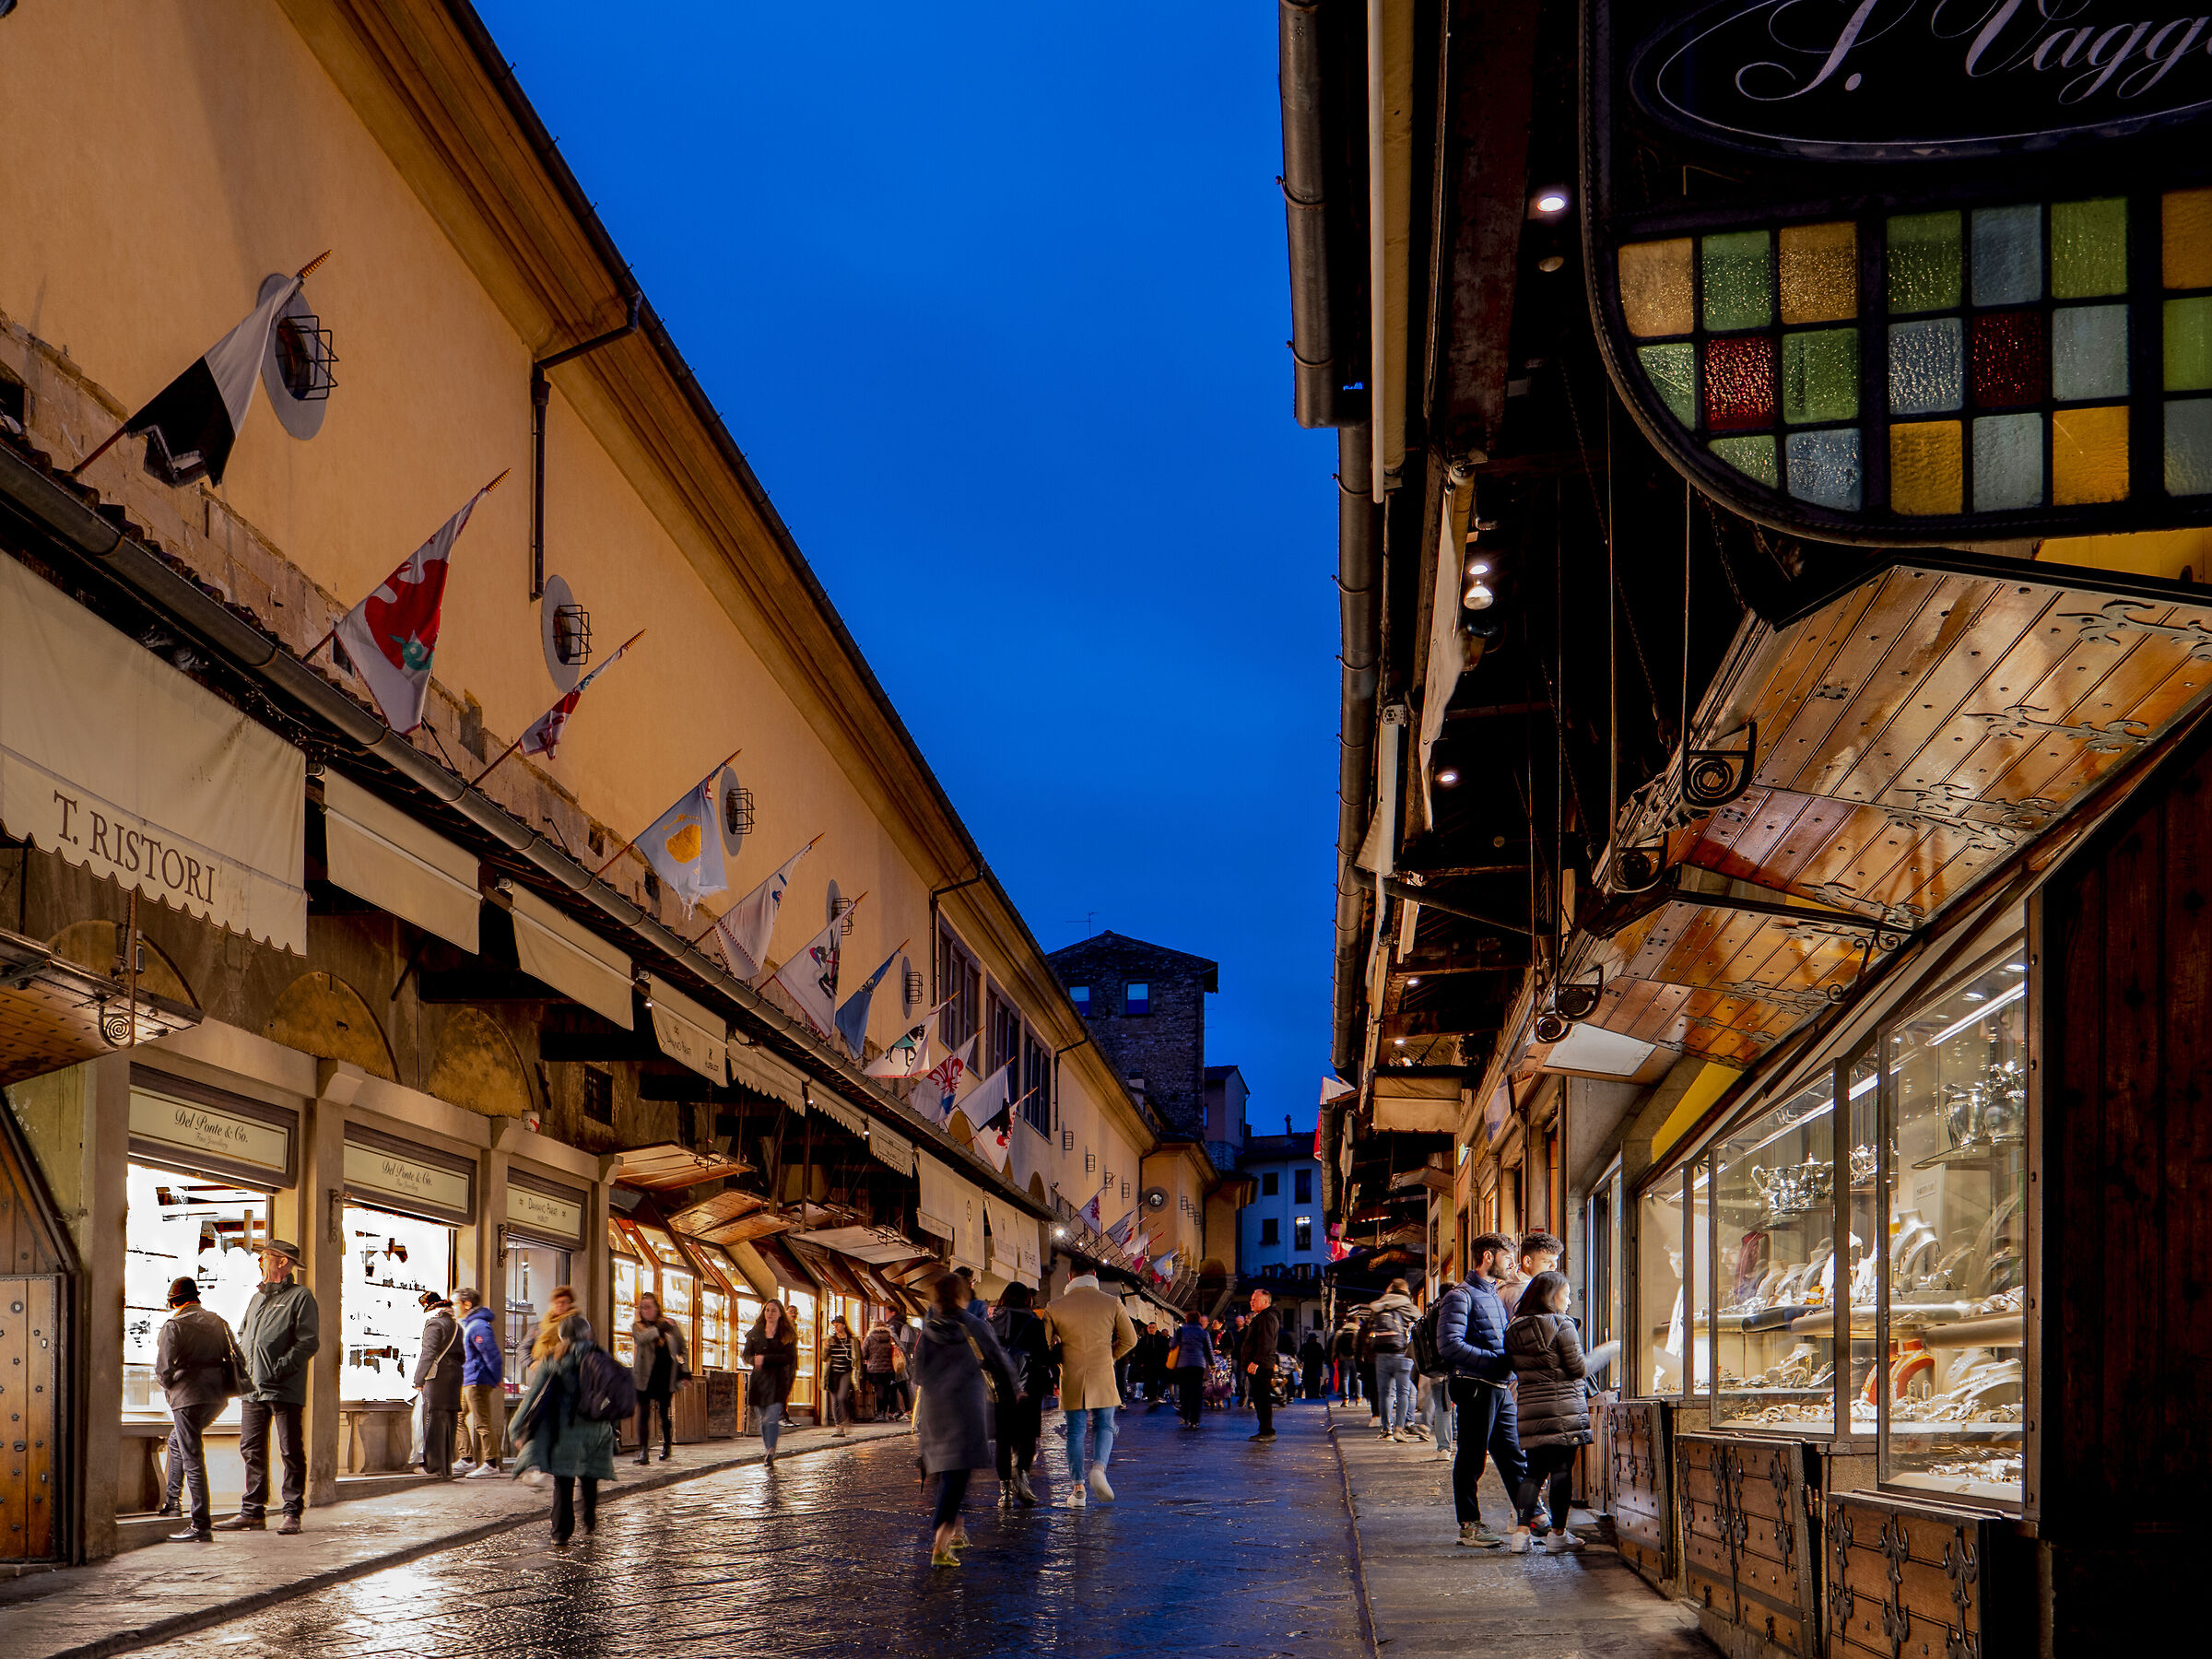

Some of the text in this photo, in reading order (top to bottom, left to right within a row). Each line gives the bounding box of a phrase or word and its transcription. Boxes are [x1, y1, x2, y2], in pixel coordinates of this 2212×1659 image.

[1932, 0, 2212, 104] Vagg
[53, 790, 216, 905] T. RISTORI
[174, 1109, 249, 1143] Del Ponte & Co.
[382, 1161, 433, 1186] Del Ponte & Co.
